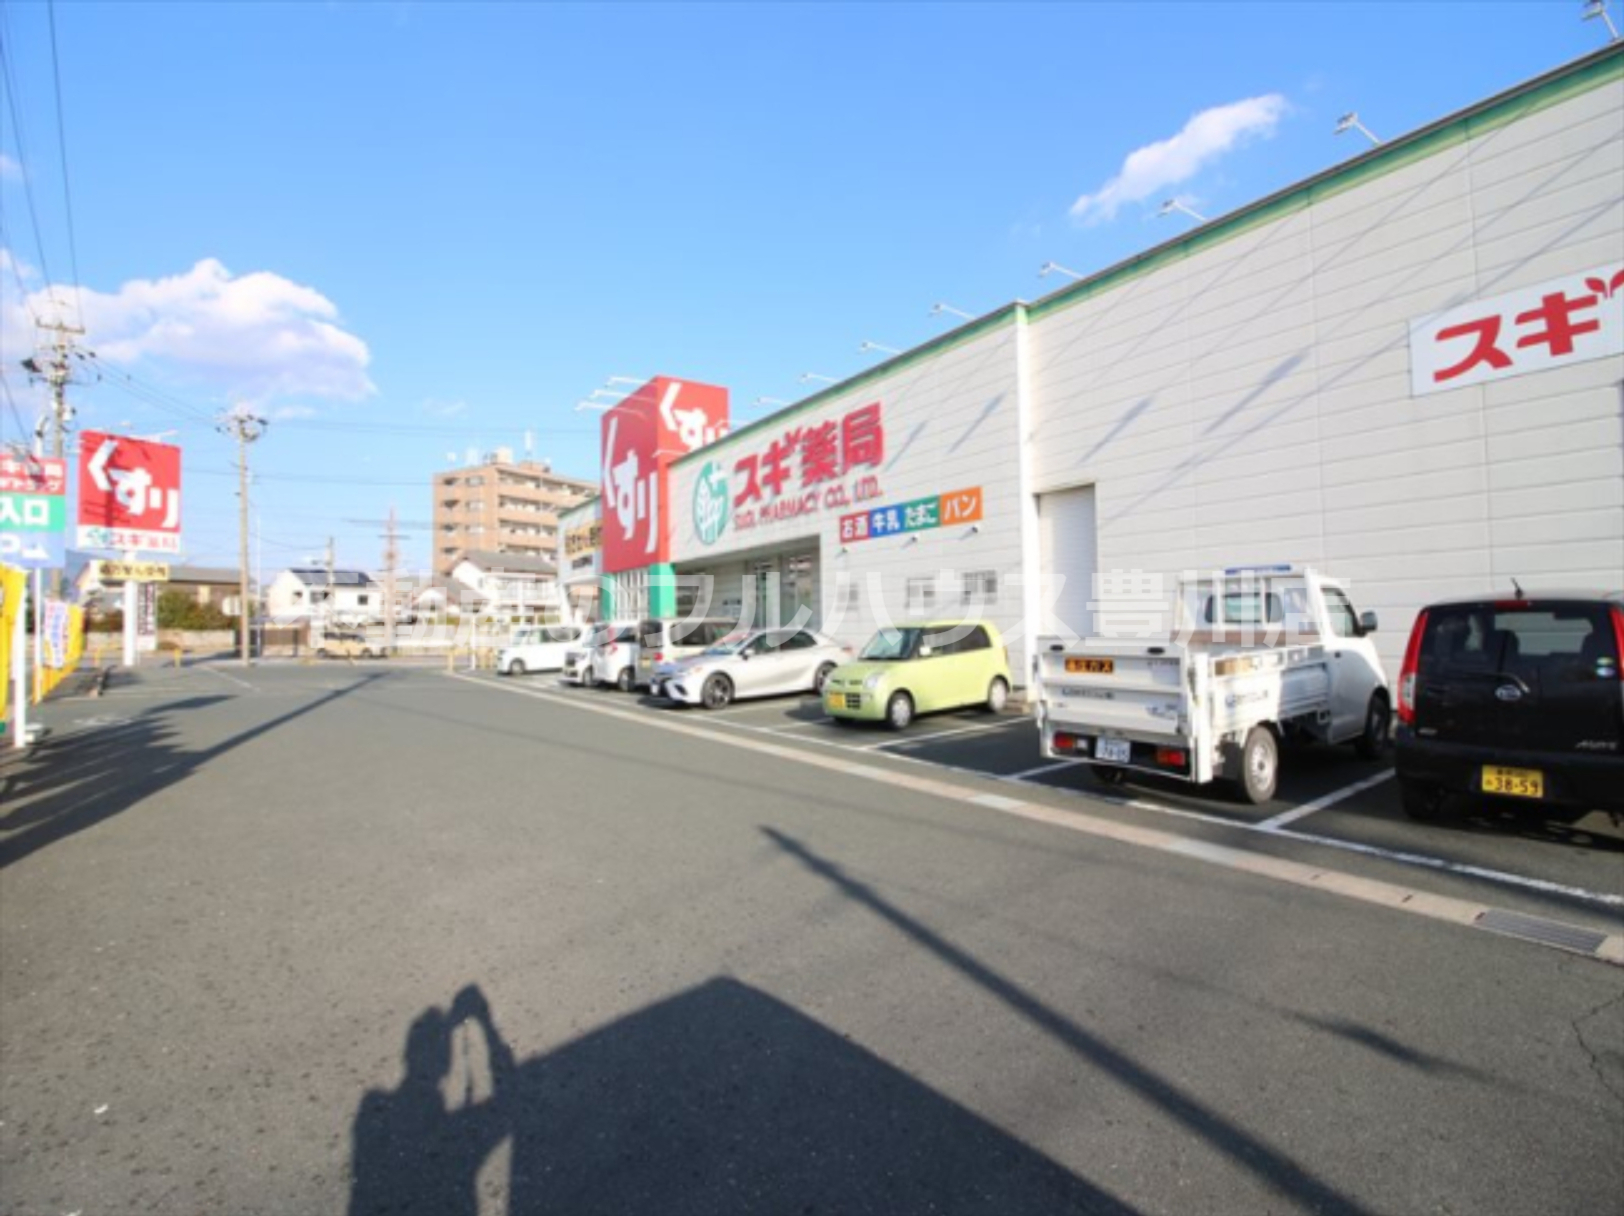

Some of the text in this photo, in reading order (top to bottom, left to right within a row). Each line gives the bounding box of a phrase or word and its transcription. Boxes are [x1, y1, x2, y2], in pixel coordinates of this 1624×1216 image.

[1432, 267, 1624, 383] スギ
[87, 439, 180, 529] くすり
[602, 416, 659, 553] くすり
[733, 402, 885, 508] スギ薬局
[872, 509, 901, 534] 牛乳
[904, 503, 938, 528] たまご
[944, 493, 977, 520] パン
